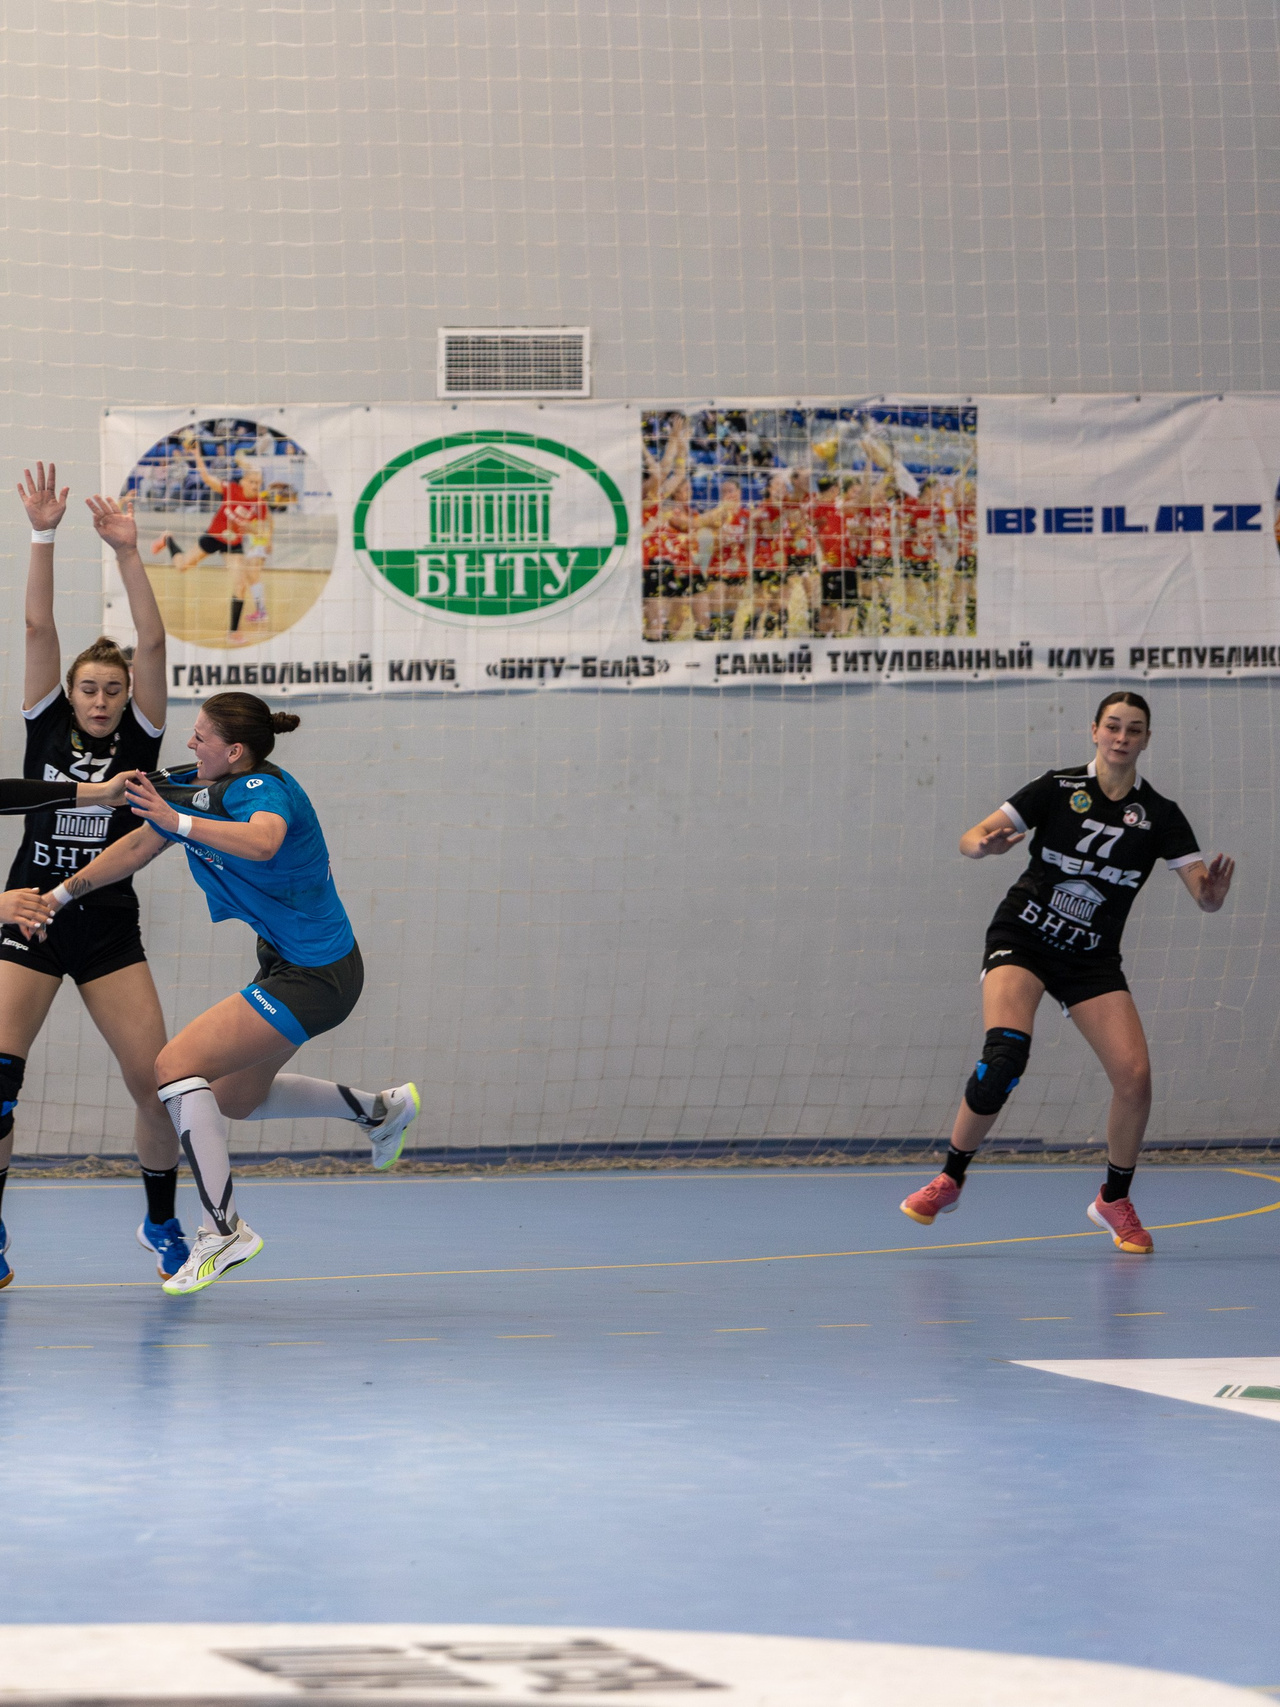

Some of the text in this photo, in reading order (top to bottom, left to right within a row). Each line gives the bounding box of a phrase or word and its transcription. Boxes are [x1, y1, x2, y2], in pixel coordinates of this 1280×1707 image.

[986, 504, 1262, 535] BELAZ
[415, 551, 580, 598] БНТУ
[172, 653, 373, 687] ГАНДБОЛЬНЫЙ
[388, 658, 456, 683] КЛУБ
[715, 644, 813, 676] САМЫЙ
[827, 641, 1034, 672] ТИТУЛОВАННЫЙ
[1048, 647, 1116, 669] КЛУБ
[1129, 645, 1280, 669] РЕСПУБЛИК
[33, 841, 102, 869] БНТ
[1075, 819, 1125, 859] 77
[1041, 847, 1142, 889] BELAZ
[1019, 900, 1102, 950] БНТУ
[251, 988, 277, 1015] Kempa
